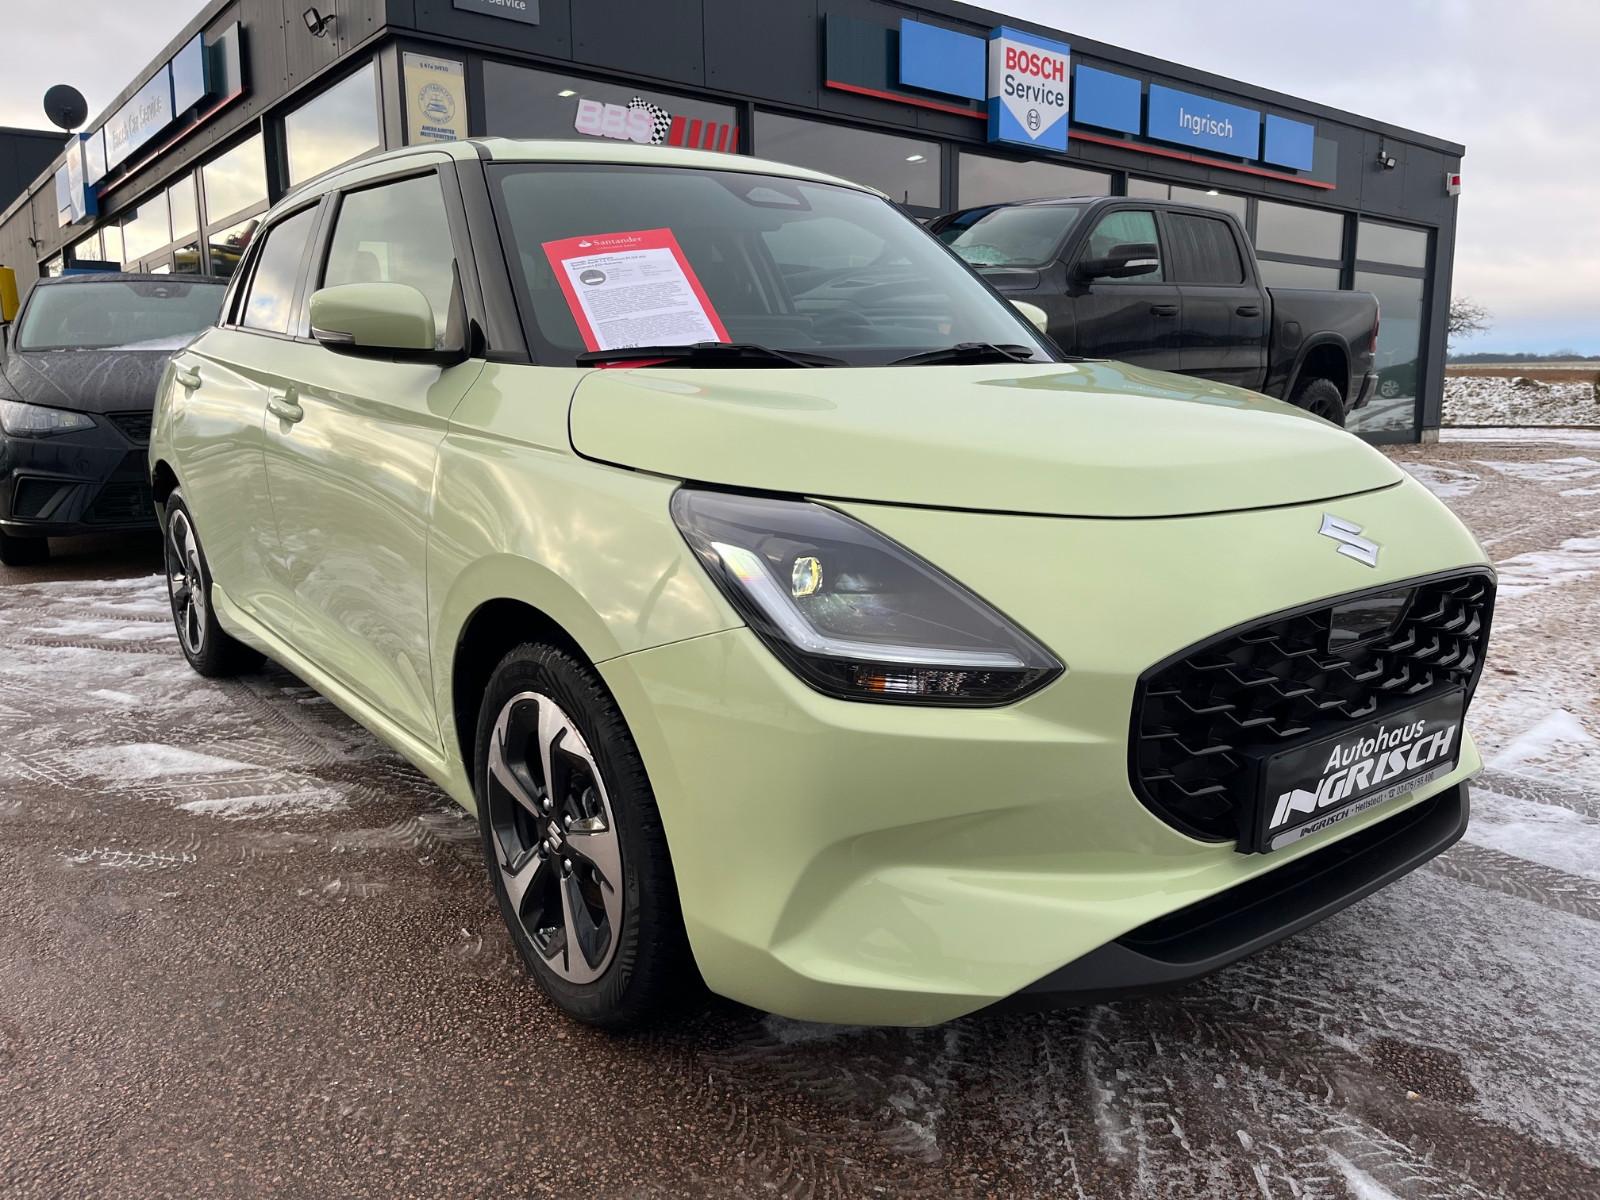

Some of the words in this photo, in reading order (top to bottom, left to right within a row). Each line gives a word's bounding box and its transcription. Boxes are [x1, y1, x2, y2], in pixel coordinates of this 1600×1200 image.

[1005, 46, 1065, 83] BOSCH
[1003, 74, 1065, 108] Service
[139, 95, 162, 128] Service
[575, 98, 654, 143] BBS
[1178, 107, 1233, 139] Ingrisch
[593, 236, 642, 246] Santander
[1323, 719, 1426, 775] Autohaus
[1269, 725, 1456, 830] INGRISCH
[1299, 809, 1349, 837] INGRISCH
